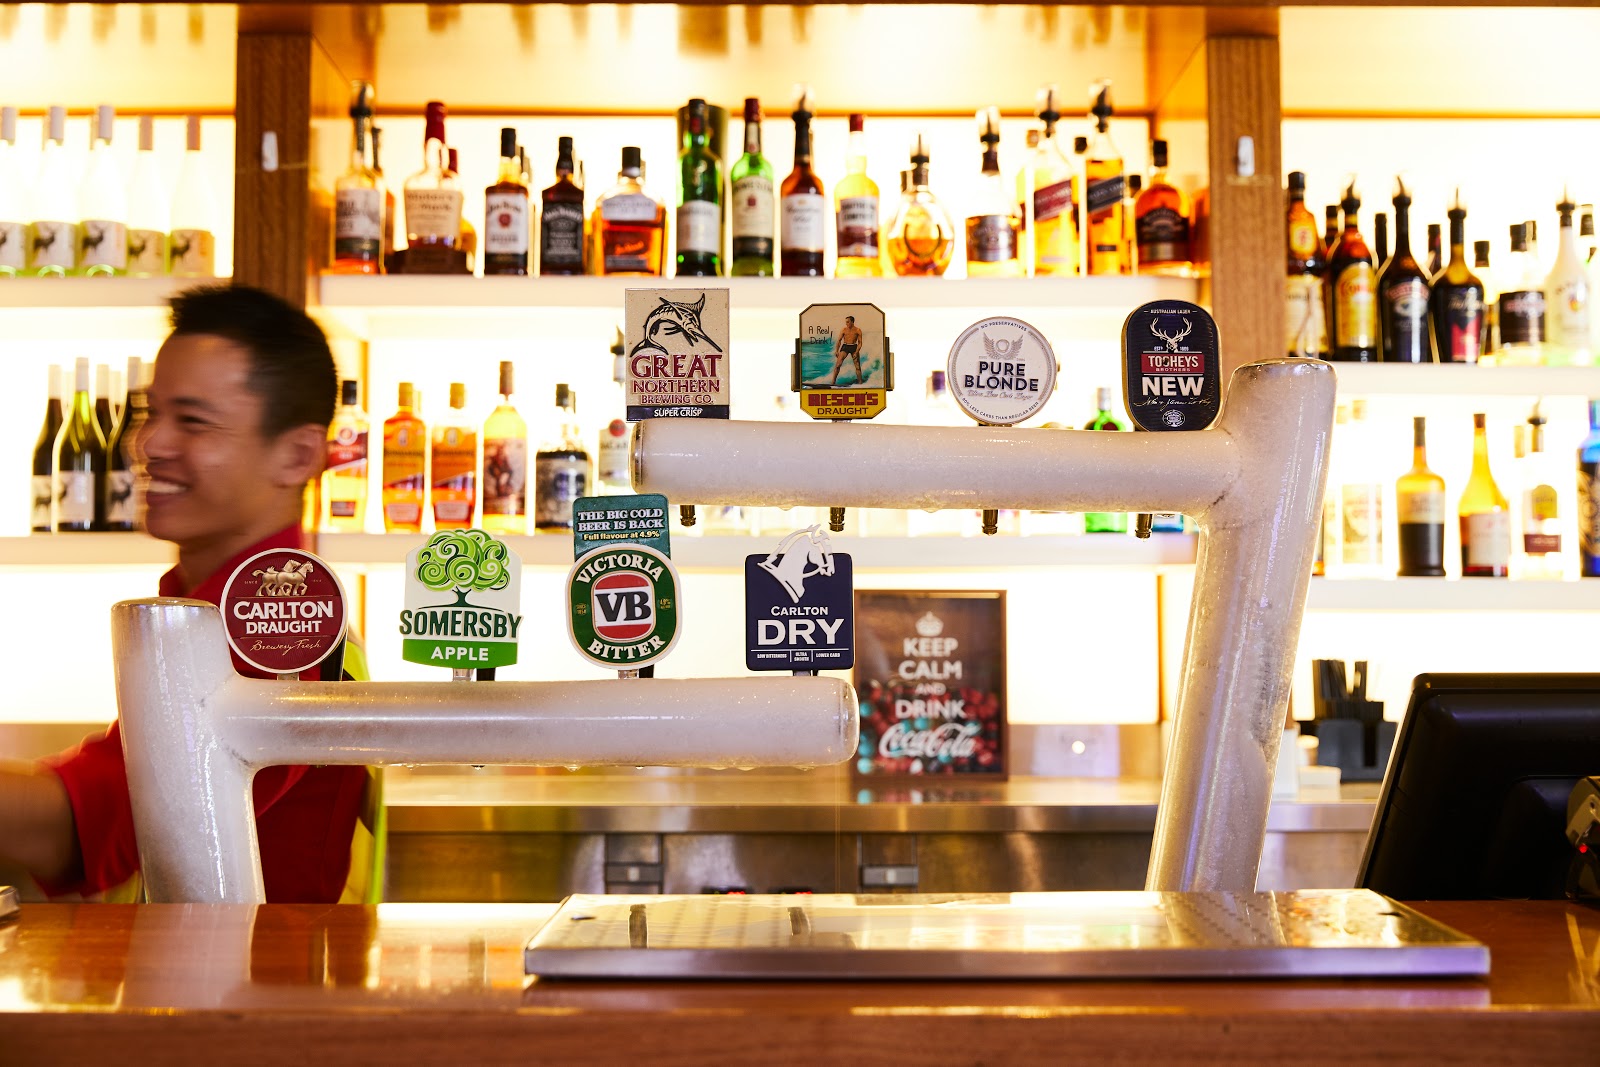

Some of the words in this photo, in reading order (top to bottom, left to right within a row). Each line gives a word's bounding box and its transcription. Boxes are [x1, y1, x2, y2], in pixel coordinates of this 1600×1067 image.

[808, 325, 814, 335] A
[816, 325, 830, 335] Real
[989, 321, 1028, 332] PRESERVATIVES
[631, 354, 723, 379] GREAT
[979, 360, 1026, 377] PURE
[1147, 355, 1199, 368] TOOHEYS
[633, 379, 720, 393] NORTHERN
[964, 374, 1039, 392] BLONDE
[1141, 376, 1204, 397] NEW
[641, 394, 691, 405] BREWING
[694, 394, 714, 404] CO.
[808, 391, 879, 407] RESCH'S
[653, 408, 679, 417] SUPER
[680, 408, 703, 417] CRISP
[817, 407, 869, 415] DRAUGHT
[969, 404, 980, 414] LESS
[979, 411, 995, 420] CARBS
[1008, 409, 1029, 420] REGULAR
[1028, 401, 1039, 412] BEER
[578, 511, 605, 521] THE
[606, 510, 628, 520] BIG
[630, 508, 664, 518] COLD
[578, 521, 611, 532] BEER
[614, 520, 626, 530] IS
[629, 518, 664, 529] BACK
[583, 533, 600, 541] Full
[600, 532, 629, 540] flavour
[639, 530, 660, 538] 4.9%
[575, 553, 664, 585] VICTORIA
[233, 600, 334, 620] CARLTON
[594, 591, 652, 623] VB
[770, 605, 829, 617] CARLTON
[245, 620, 322, 635] DRAUGHT
[399, 609, 522, 639] SOMERSBY
[757, 618, 845, 646] DRY
[250, 640, 295, 656] Brewery
[293, 639, 322, 650] Fresh
[430, 646, 489, 661] APPLE
[587, 634, 666, 660] BITTER
[902, 637, 959, 657] KEEP
[898, 660, 963, 680] CALM
[914, 682, 946, 696] AND
[895, 699, 968, 719] DRINK
